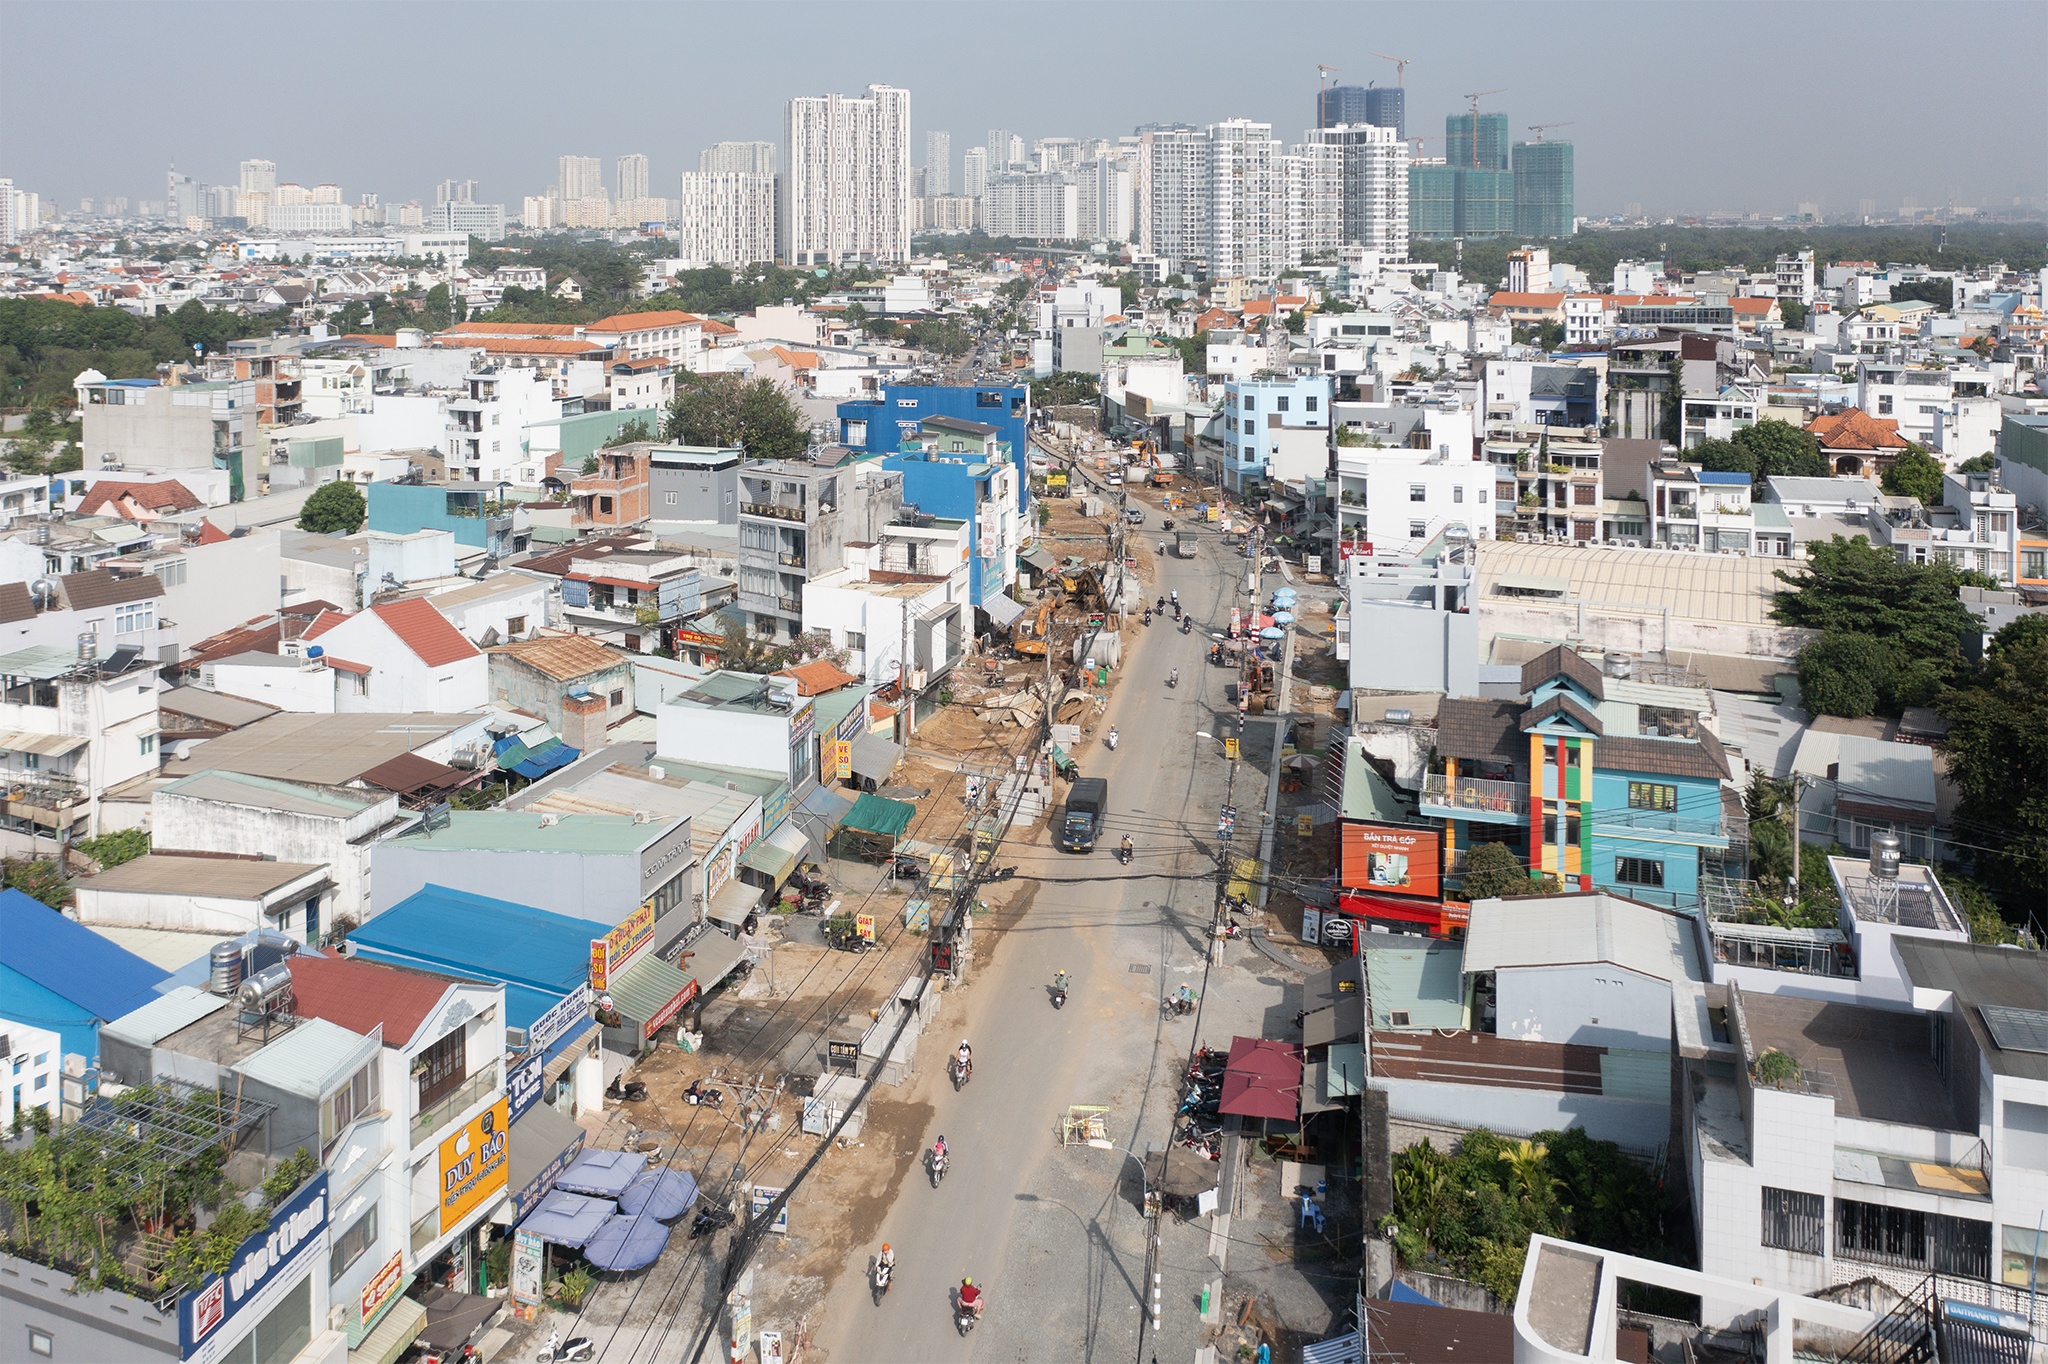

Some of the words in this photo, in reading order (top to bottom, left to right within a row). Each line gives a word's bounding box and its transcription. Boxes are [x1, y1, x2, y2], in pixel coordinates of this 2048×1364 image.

[1364, 832, 1380, 841] BÁN
[1382, 834, 1398, 843] TRẢ
[1400, 836, 1416, 844] GÓP
[515, 1080, 540, 1110] COFFEE
[446, 1152, 475, 1192] DUY
[230, 1196, 324, 1302] viettien
